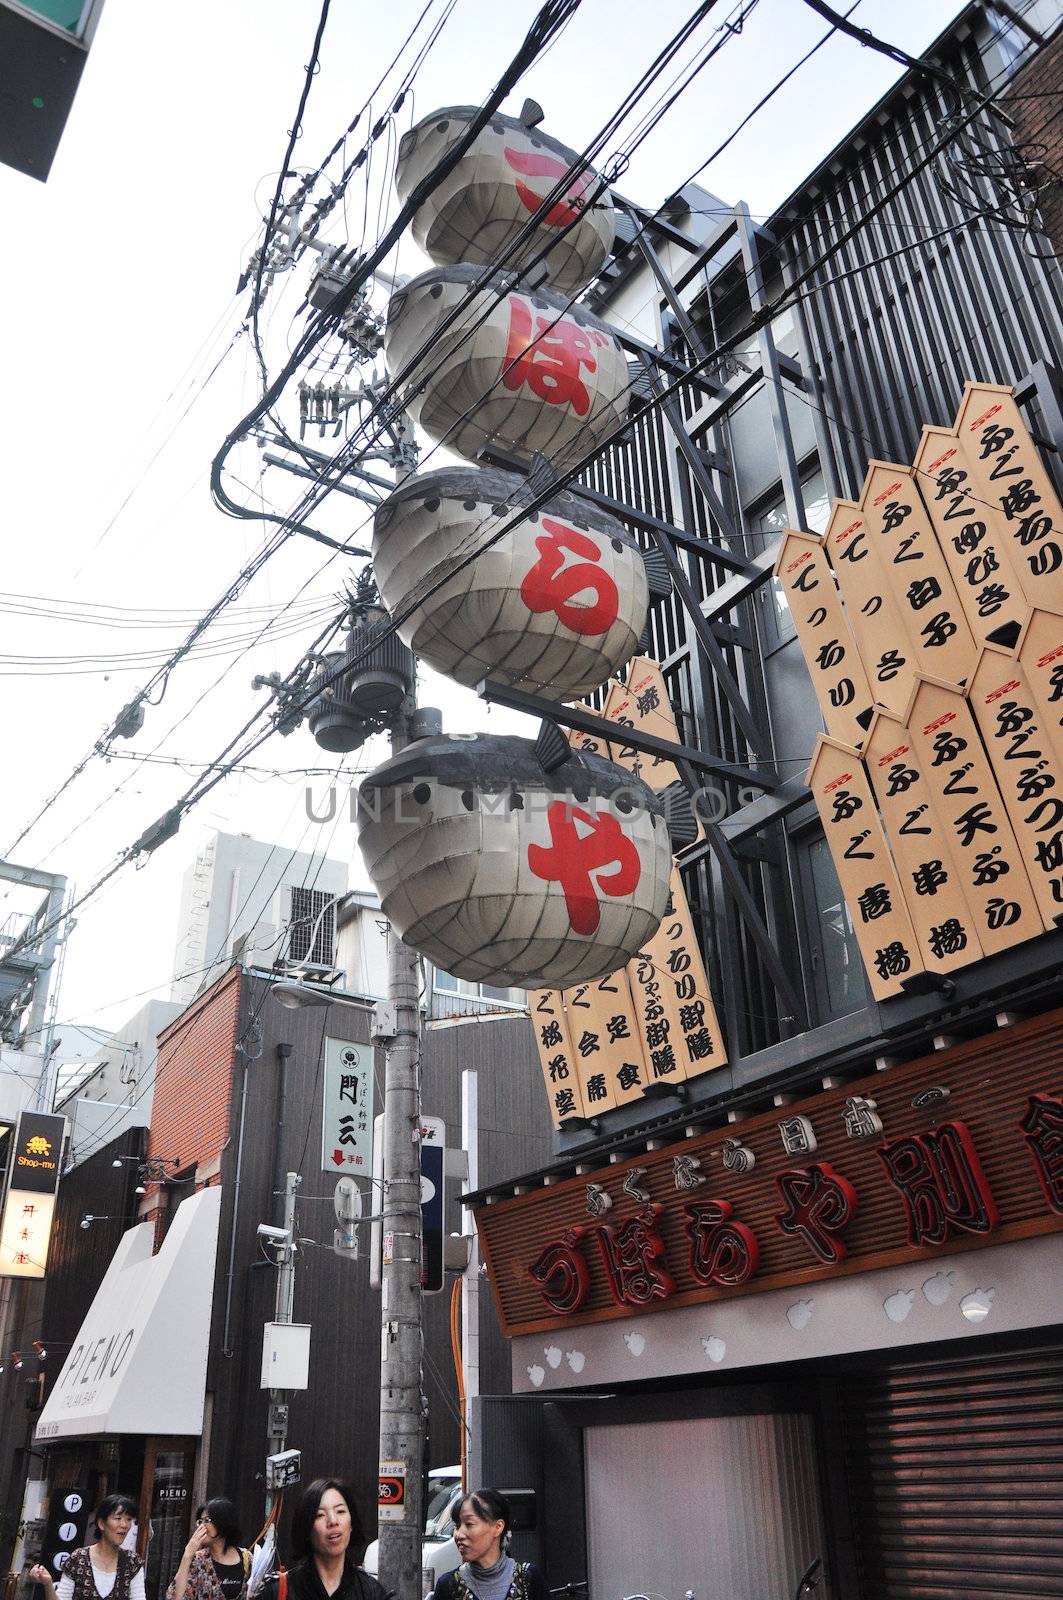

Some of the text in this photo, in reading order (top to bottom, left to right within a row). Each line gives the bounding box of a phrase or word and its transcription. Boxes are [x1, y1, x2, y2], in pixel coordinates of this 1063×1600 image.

[18, 1157, 55, 1169] Shop-mu
[347, 1155, 363, 1165] 手前
[60, 1328, 134, 1389] PIENO
[159, 1489, 187, 1497] PIENO
